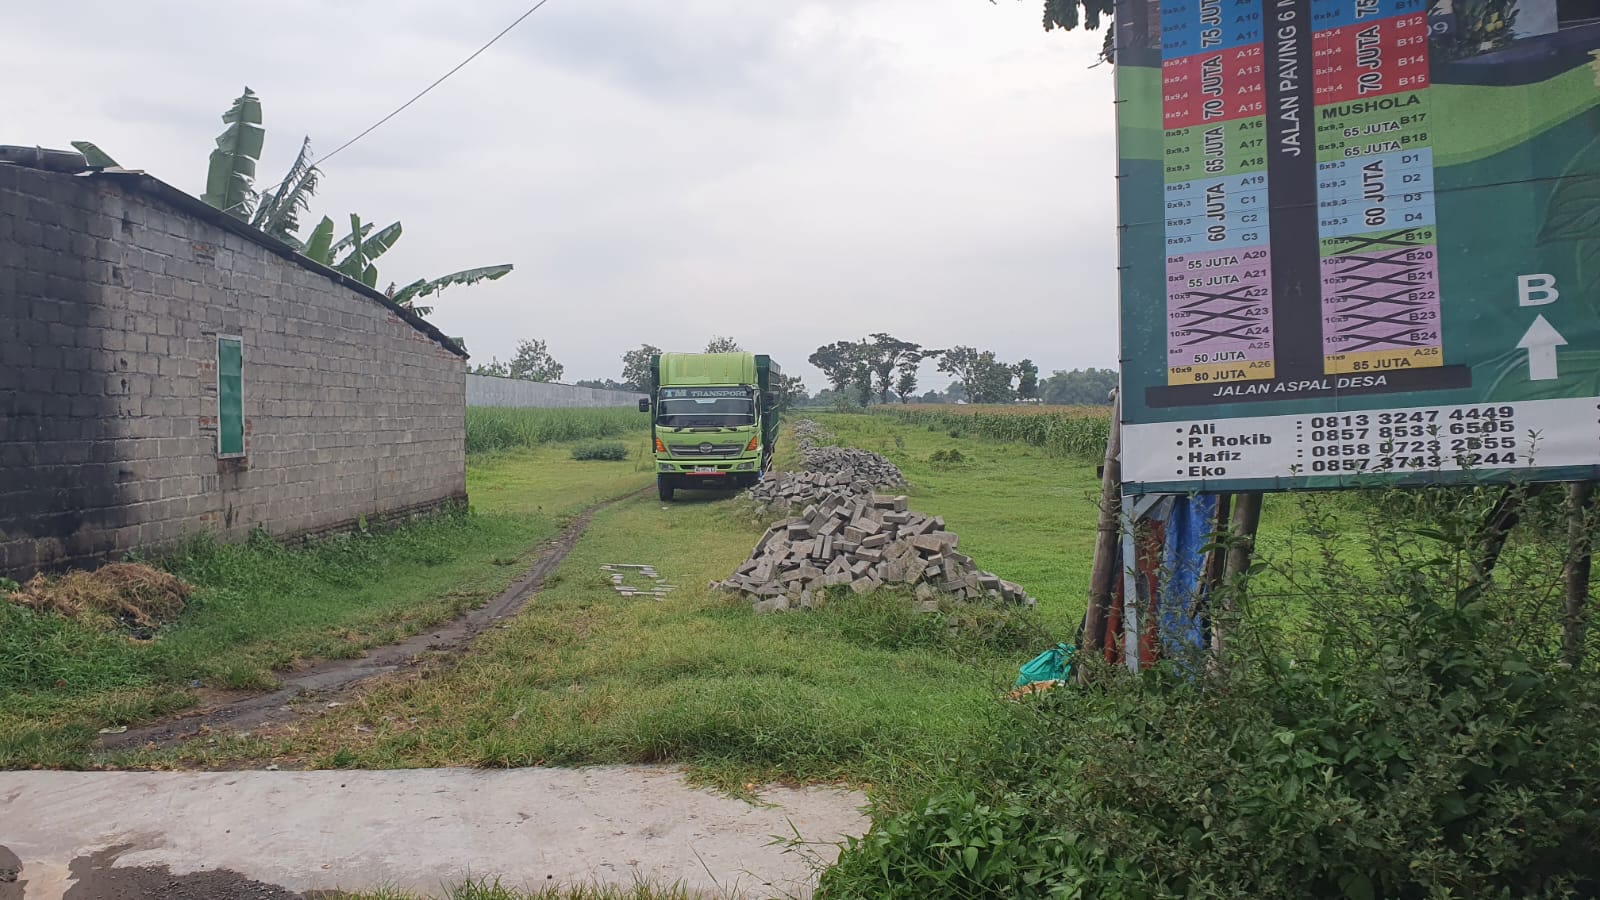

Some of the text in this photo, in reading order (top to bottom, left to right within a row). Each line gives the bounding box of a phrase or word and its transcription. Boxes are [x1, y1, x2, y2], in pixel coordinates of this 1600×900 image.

[1278, 10, 1296, 21] 6
[1397, 17, 1422, 28] B12
[1201, 28, 1222, 48] 75
[1397, 36, 1423, 46] B13
[1237, 48, 1260, 58] A12
[1278, 26, 1298, 92] PAVING
[1356, 25, 1382, 94] 70 JUTA
[1398, 56, 1424, 66] B14
[1237, 66, 1261, 76] A13
[1399, 75, 1425, 86] B15
[1202, 55, 1225, 120] 70 JUTA
[1238, 84, 1262, 94] A14
[1238, 102, 1262, 112] A15
[1322, 94, 1420, 120] MUSHOLA
[1400, 113, 1426, 124] B17
[1239, 120, 1263, 130] A16
[1280, 96, 1300, 156] JALAN
[1343, 120, 1400, 138] 65 JUTA
[1402, 133, 1428, 144] B18
[1240, 139, 1263, 149] A17
[1344, 140, 1401, 156] 65 JUTA
[1205, 126, 1225, 174] 65 JUTA
[1240, 158, 1264, 167] A18
[1402, 154, 1419, 164] D1
[1241, 176, 1264, 186] A19
[1402, 174, 1421, 182] D2
[1363, 160, 1386, 226] 60 JUTA
[1404, 193, 1422, 202] D3
[1241, 196, 1256, 204] C1
[1207, 182, 1226, 242] 60 JUTA
[1242, 214, 1258, 222] C2
[1404, 213, 1422, 222] D4
[1405, 231, 1432, 241] B19
[1243, 250, 1266, 260] A20
[1406, 251, 1433, 260] B20
[1188, 256, 1238, 269] 55 JUTA
[1244, 270, 1266, 278] A21
[1408, 271, 1433, 280] B21
[1188, 275, 1240, 288] 55 JUTA
[1244, 288, 1268, 298] A22
[1518, 274, 1559, 306] B
[1408, 291, 1435, 300] B22
[1244, 308, 1269, 316] A23
[1410, 312, 1436, 320] B23
[1245, 326, 1270, 335] A24
[1410, 332, 1437, 341] B24
[1248, 342, 1270, 350] A25
[1414, 348, 1438, 356] A25
[1194, 352, 1246, 363] 50 JUTA
[1353, 358, 1411, 370] 85 JUTA
[1170, 366, 1192, 374] 10x9
[1194, 370, 1246, 381] 80 JUTA
[1213, 376, 1388, 397] JALAN ASPAL DESA
[1188, 424, 1216, 434] Ali
[1312, 415, 1369, 428] 0813
[1378, 410, 1439, 424] 3247
[1449, 406, 1514, 420] 4449
[1188, 438, 1203, 448] P.
[1212, 434, 1272, 446] Rokib
[1312, 428, 1369, 441] 0857
[1379, 424, 1437, 438] 853
[1450, 421, 1514, 434] 6505
[1188, 452, 1242, 464] Hafiz
[1312, 444, 1370, 456] 0858
[1380, 440, 1441, 453] 0723
[1188, 466, 1226, 477] Eko
[1312, 459, 1370, 471] 0857
[1380, 456, 1442, 468] 3743
